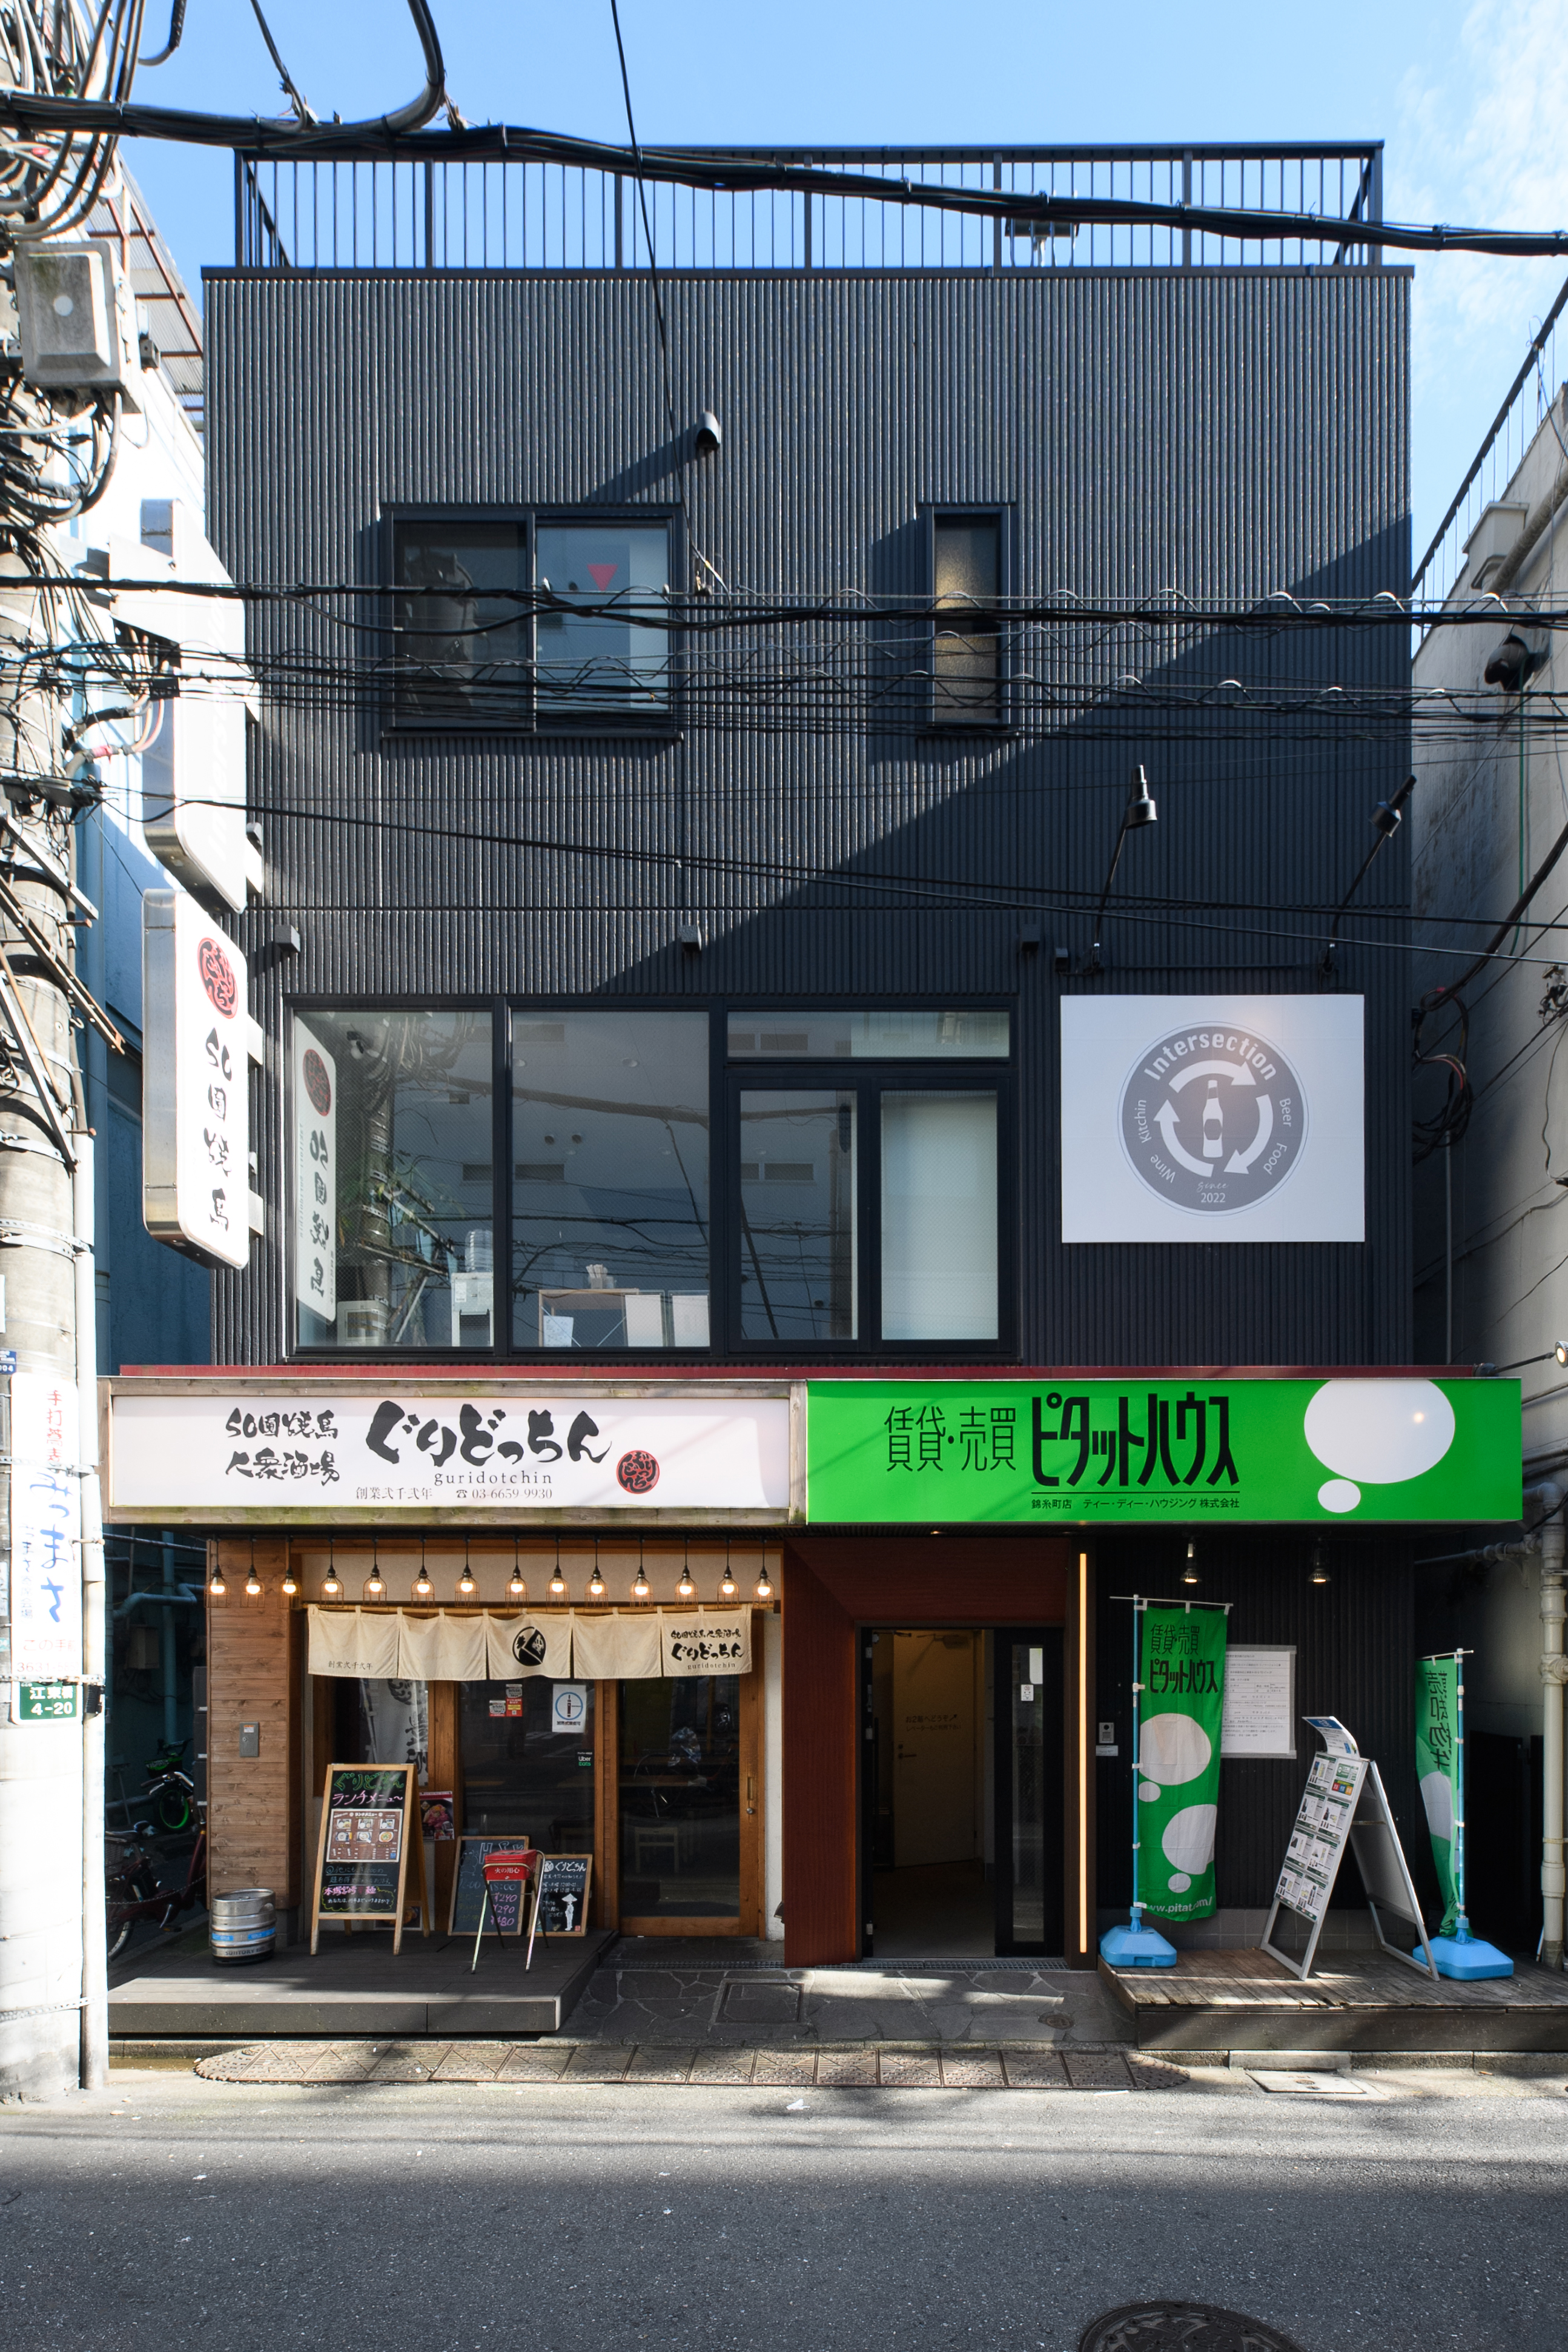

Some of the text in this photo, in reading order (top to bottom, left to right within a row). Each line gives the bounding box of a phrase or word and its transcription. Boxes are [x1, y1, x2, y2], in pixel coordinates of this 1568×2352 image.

[1144, 1033, 1277, 1080] Intersection
[1134, 1099, 1152, 1143] Kitchin
[1279, 1098, 1291, 1127] Beer
[1150, 1154, 1176, 1183] Wine
[1263, 1142, 1288, 1175] Food
[1200, 1193, 1226, 1204] 2022
[366, 1400, 612, 1466] ぐりどっちん
[884, 1406, 1016, 1472] 賃貸・売買
[1031, 1392, 1240, 1486] ピタットハウス
[434, 1471, 552, 1486] guridotchin
[472, 1488, 552, 1499] 03-6659-9930
[1031, 1499, 1071, 1509] 錦糸町店
[1200, 1498, 1240, 1508] 株式会社
[671, 1642, 744, 1661] ぐりどっちん
[1151, 1658, 1219, 1694] ピタットハウス
[29, 1686, 73, 1700] 江東橋
[31, 1701, 73, 1715] 4-20
